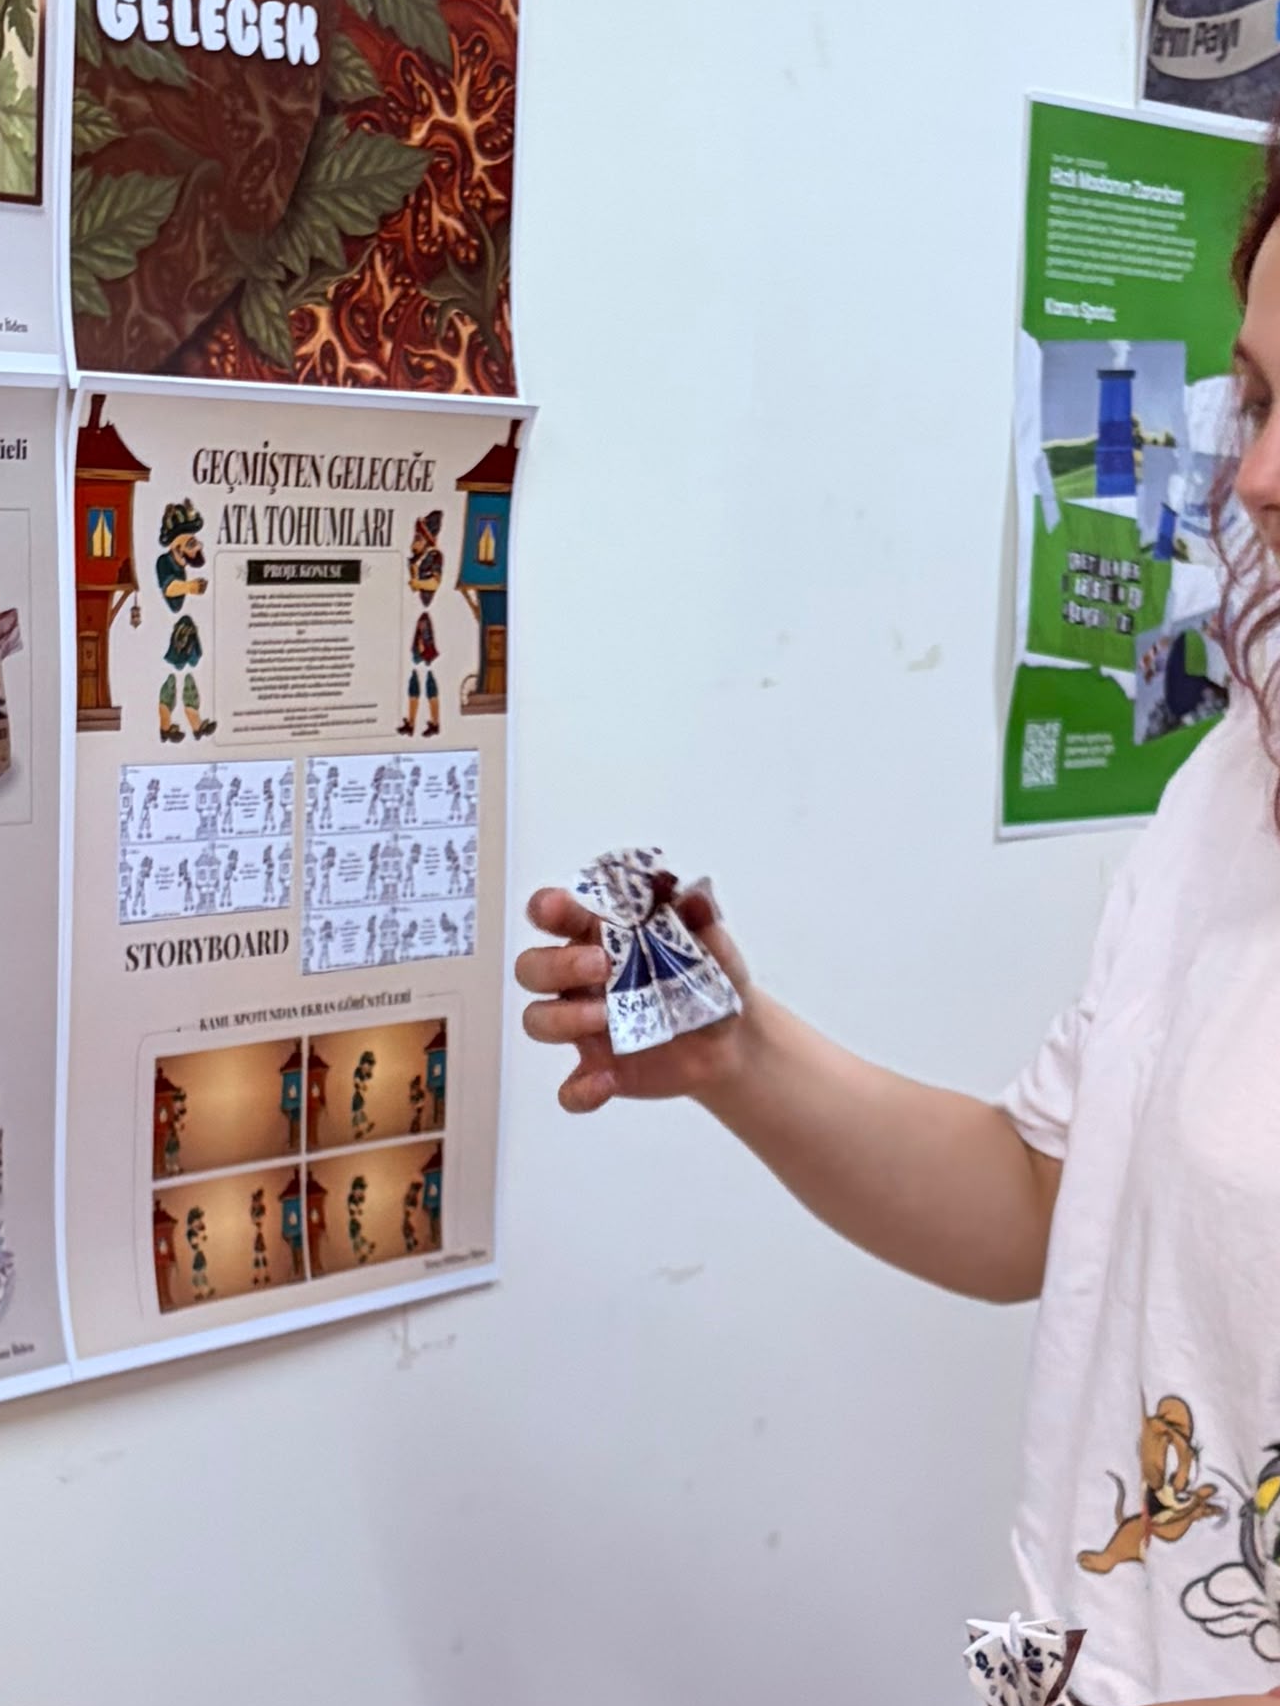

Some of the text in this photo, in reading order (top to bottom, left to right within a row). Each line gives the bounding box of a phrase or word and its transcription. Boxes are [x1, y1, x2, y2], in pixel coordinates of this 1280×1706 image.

[192, 441, 437, 495] GEÇMİŞTEN GELECEĞE
[217, 504, 395, 548] ATA TOHUMLARI
[124, 927, 290, 973] STORYBOARD
